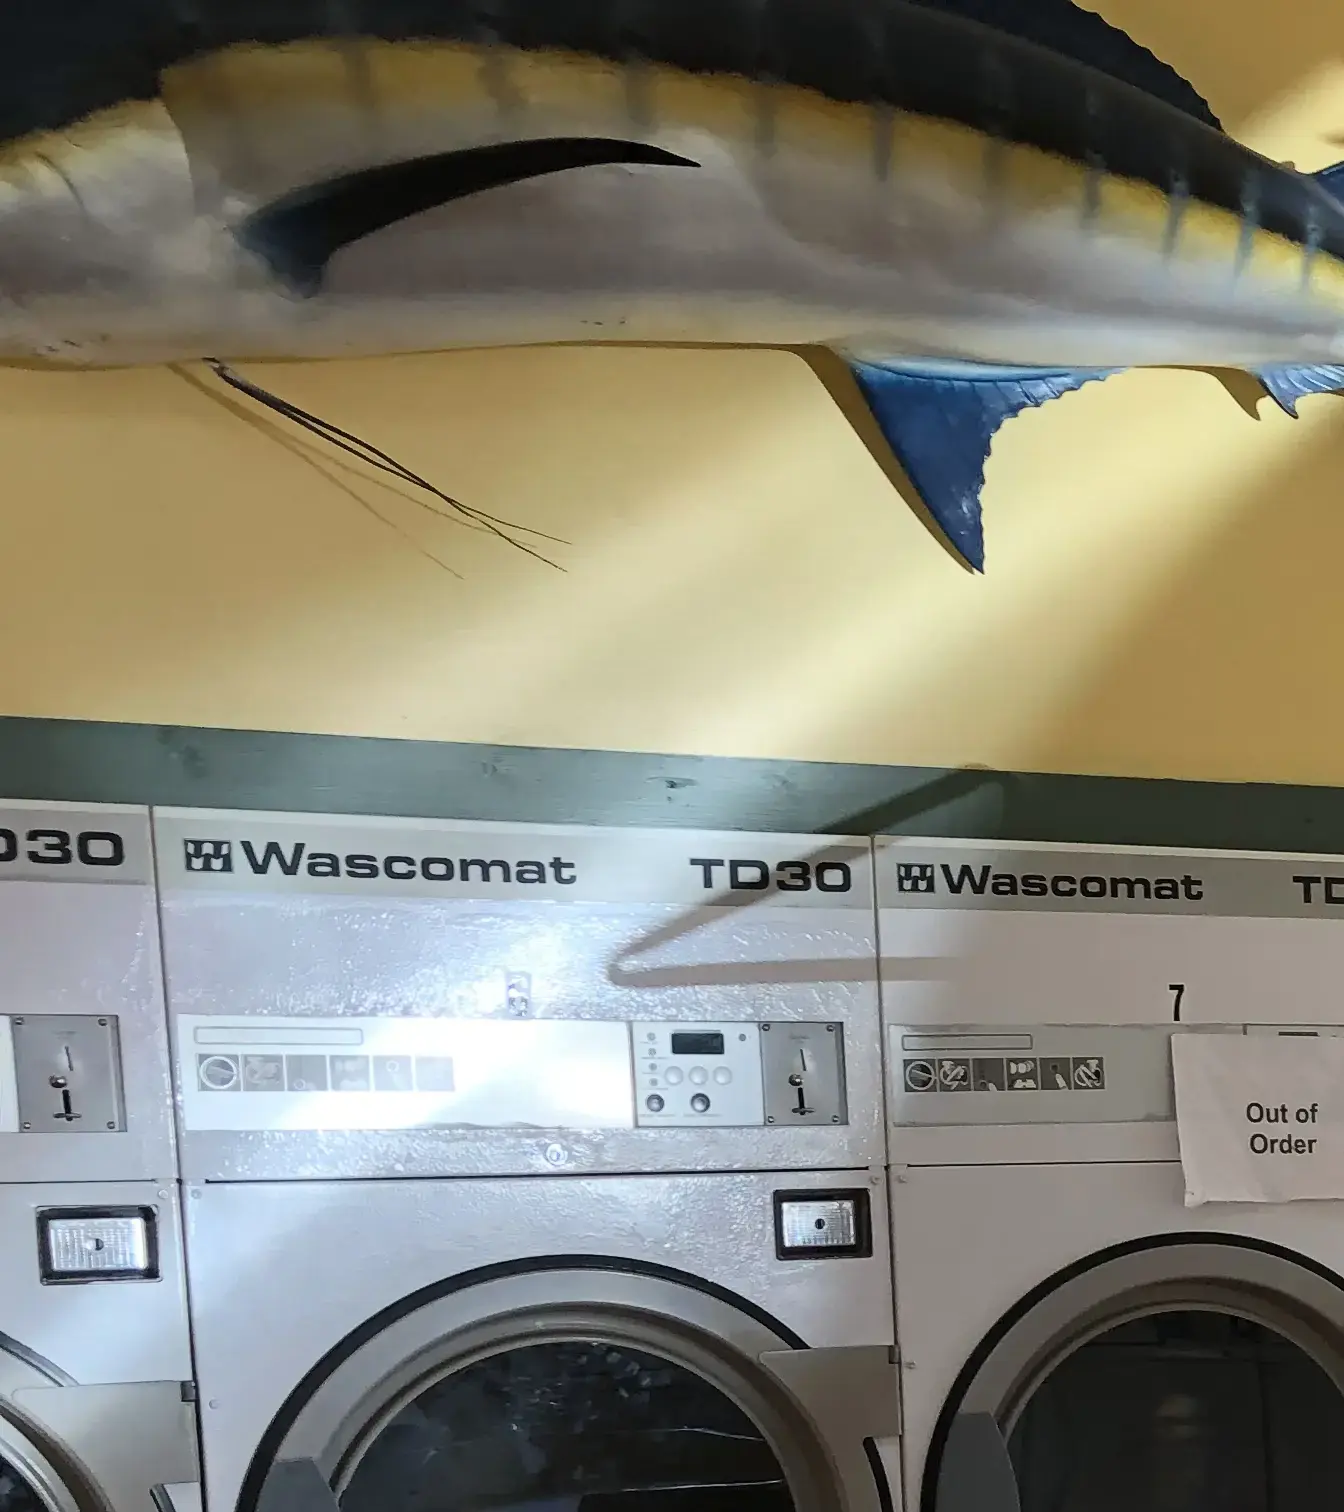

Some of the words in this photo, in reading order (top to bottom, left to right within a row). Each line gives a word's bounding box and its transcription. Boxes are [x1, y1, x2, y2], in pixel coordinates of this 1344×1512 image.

[239, 840, 577, 885] Wascomat
[690, 858, 852, 893] TD30
[940, 863, 1204, 901] Wascomat
[1168, 984, 1185, 1022] 7
[1246, 1102, 1288, 1124] Out
[1295, 1103, 1319, 1124] of
[1249, 1133, 1318, 1155] Order
